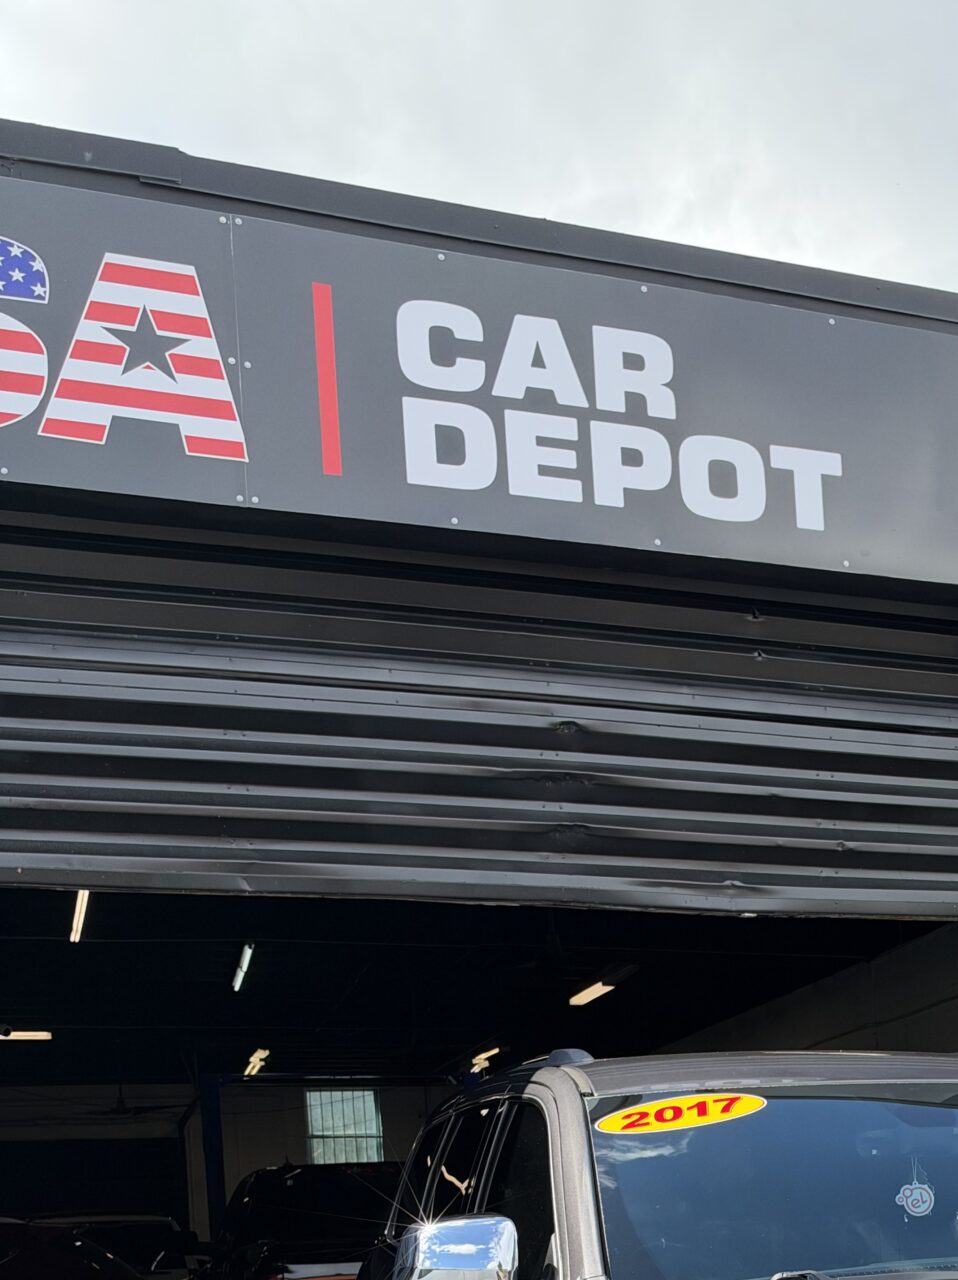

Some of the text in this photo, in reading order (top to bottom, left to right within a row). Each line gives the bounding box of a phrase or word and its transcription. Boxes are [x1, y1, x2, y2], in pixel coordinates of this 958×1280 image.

[397, 299, 677, 420] CAR
[401, 397, 843, 531] DEPOT
[620, 1096, 743, 1131] 2017
